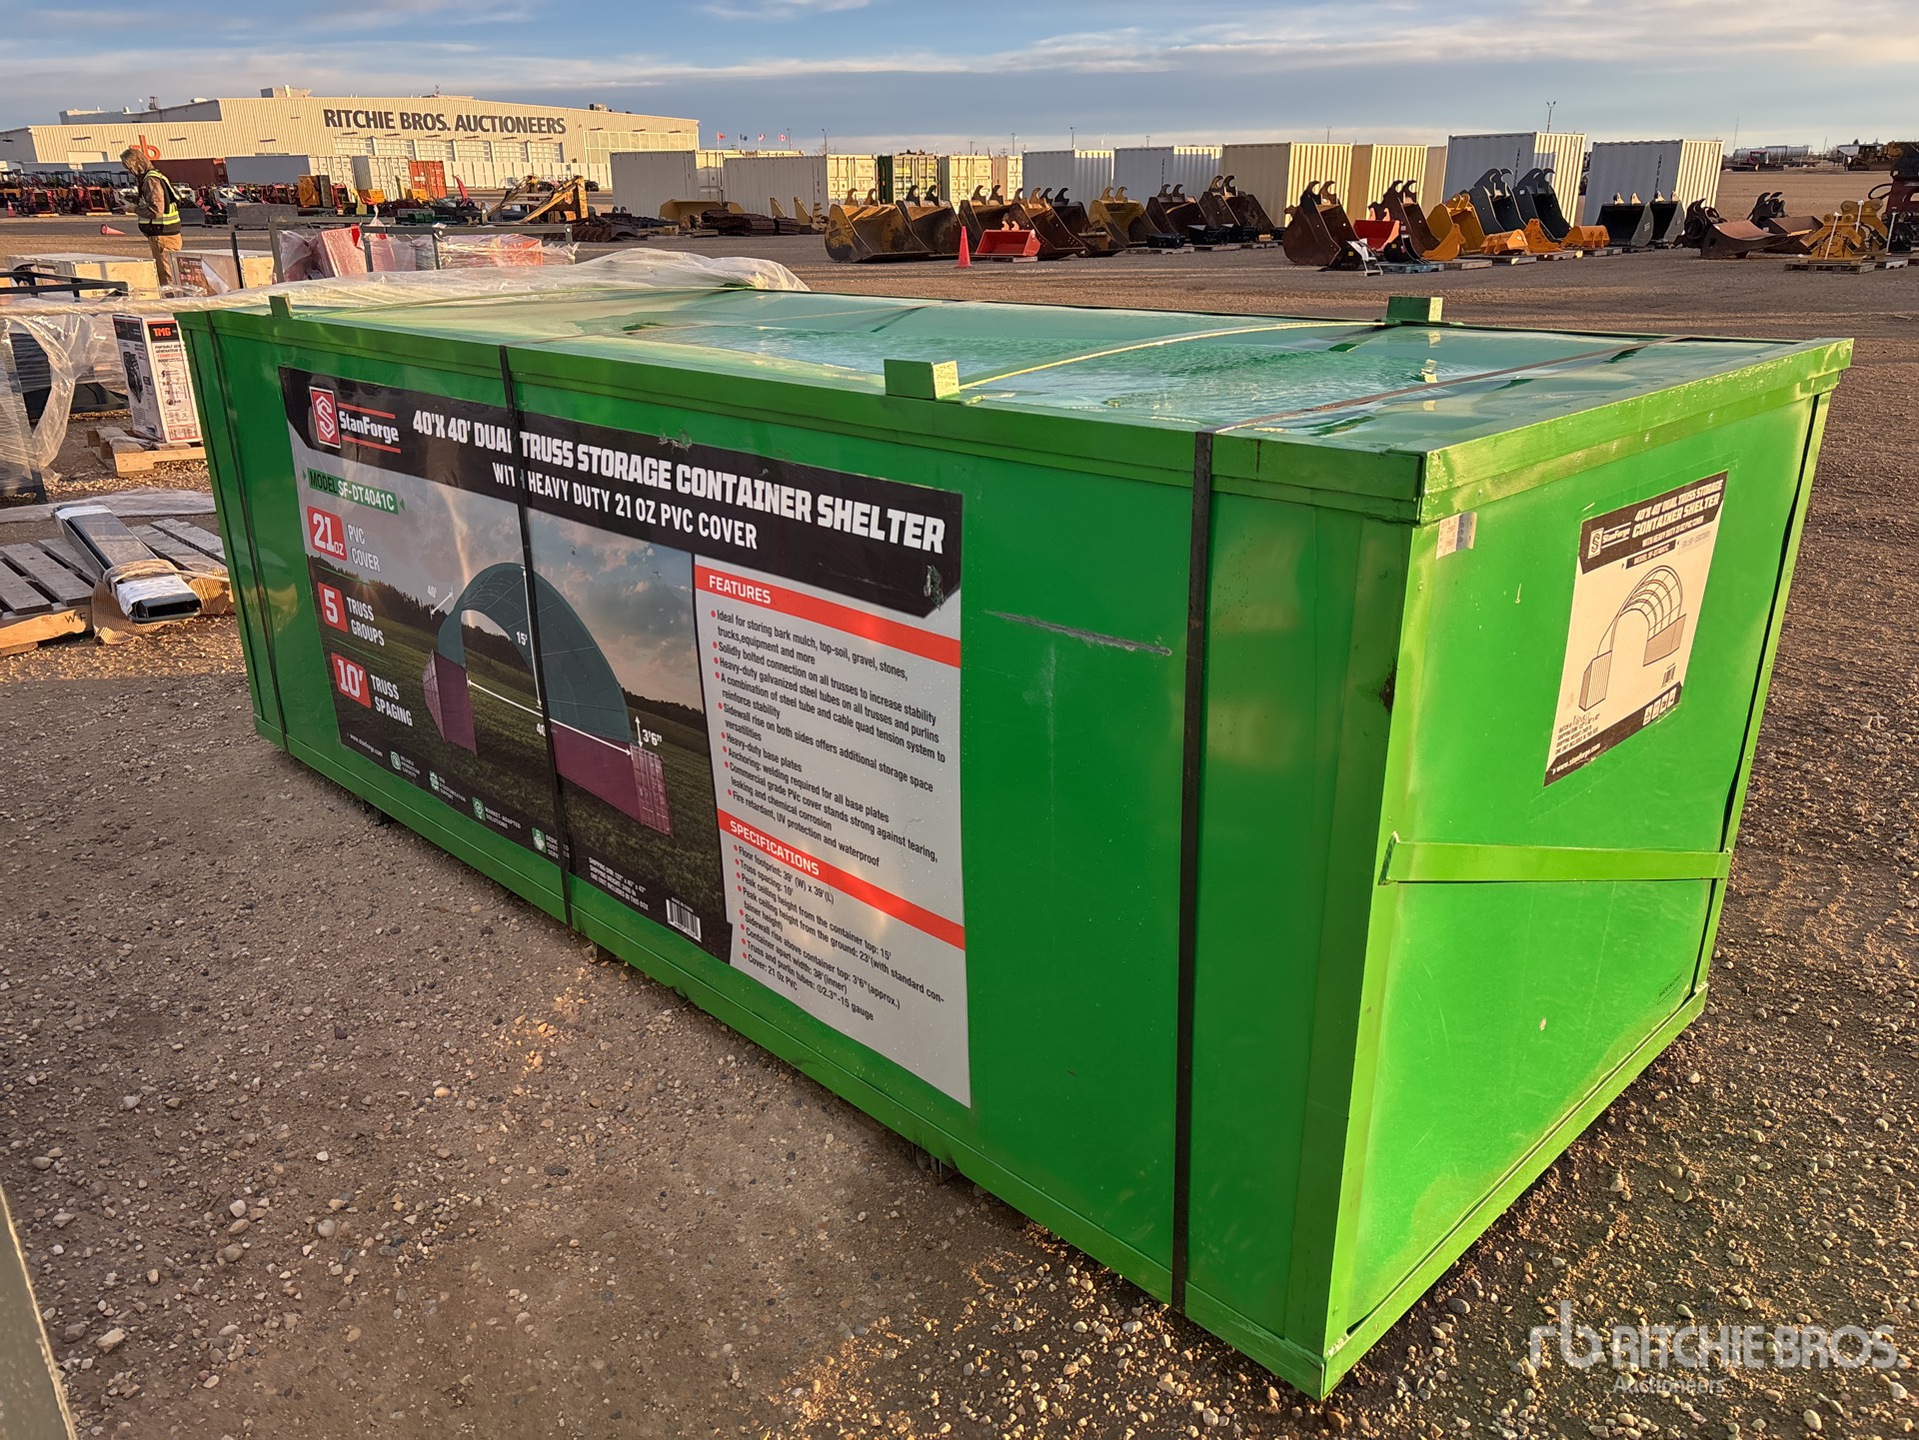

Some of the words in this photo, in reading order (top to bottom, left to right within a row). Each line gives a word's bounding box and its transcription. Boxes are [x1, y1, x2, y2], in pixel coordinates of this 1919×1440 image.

[324, 109, 395, 130] RITCHIE
[400, 112, 451, 131] BROS.
[454, 114, 566, 134] AUCTIONEERS
[153, 328, 171, 336] TMG
[338, 410, 399, 444] StanForge
[309, 470, 337, 494] MODEL
[337, 480, 394, 510] SF-DT4041C
[447, 417, 470, 443] 40'
[519, 431, 573, 468] TRUSS
[577, 444, 671, 490] STORAGE
[676, 464, 811, 523] CONTAINER
[817, 494, 945, 553] SHELTER
[527, 470, 568, 501] HEAVY
[572, 482, 609, 512] DUTY
[614, 493, 631, 518] 21
[635, 497, 656, 524] OZ
[660, 503, 693, 533] PVC
[698, 512, 756, 549] COVER
[1632, 507, 1683, 538] CONTAINER
[1683, 492, 1720, 518] SHELTER
[347, 524, 365, 544] PVC
[351, 547, 380, 572] COVER
[323, 588, 338, 623] 5
[346, 596, 374, 621] TRUSS
[709, 575, 770, 604] FEATURES
[350, 619, 384, 646] GROUPS
[716, 609, 734, 624] Ideal
[735, 614, 745, 627] for
[746, 620, 772, 638] storing
[774, 626, 791, 641] bark
[792, 634, 818, 651] mulch,
[819, 640, 850, 661] top-soil,
[851, 652, 878, 671] gravel,
[879, 661, 907, 681] stones,
[780, 646, 794, 658] and
[796, 651, 815, 665] more
[337, 659, 363, 698] 10'
[370, 674, 399, 700] TRUSS
[718, 641, 741, 659] Solidly
[742, 649, 765, 665] bolted
[766, 658, 806, 678] connection
[808, 672, 818, 682] on
[819, 674, 829, 686] all
[830, 677, 858, 696] trusses
[859, 687, 867, 699] to
[869, 690, 902, 712] increase
[904, 705, 936, 726] stability
[719, 656, 757, 680] Heavy-duty
[759, 672, 798, 692] galvanized
[799, 685, 817, 698] steel
[819, 690, 840, 706] tubes
[841, 699, 851, 710] on
[853, 702, 863, 714] all
[864, 706, 892, 725] trusses
[894, 719, 909, 732] and
[911, 725, 939, 743] purlins
[721, 672, 726, 683] A
[726, 676, 768, 698] combination
[770, 691, 777, 701] of
[779, 694, 797, 708] steel
[798, 699, 815, 714] tube
[816, 707, 831, 720] and
[832, 713, 853, 728] cable
[855, 721, 874, 735] quad
[876, 727, 904, 747] tension
[906, 740, 935, 759] system
[937, 750, 945, 763] to
[722, 689, 751, 707] reinforce
[752, 700, 780, 719] stability
[723, 702, 750, 722] Sidewall
[751, 715, 764, 728] rise
[766, 721, 775, 731] on
[776, 723, 792, 738] both
[794, 730, 814, 746] sides
[815, 738, 837, 754] offers
[839, 748, 877, 769] additional
[878, 762, 908, 782] storage
[909, 775, 933, 792] space
[724, 719, 762, 741] versatilities
[726, 732, 761, 758] Heavy-duty
[762, 748, 779, 763] base
[780, 756, 802, 772] plates
[729, 761, 766, 786] Commercial
[767, 781, 786, 796] grade
[802, 796, 822, 810] cover
[823, 805, 848, 822] stands
[850, 816, 875, 835] strong
[876, 827, 906, 847] against
[907, 838, 937, 862] tearing,
[730, 776, 753, 796] leaking
[754, 789, 766, 801] and
[767, 795, 797, 815] chemical
[798, 809, 832, 831] corrosion
[762, 764, 789, 784] welding
[790, 776, 820, 795] required
[821, 787, 832, 800] for
[833, 793, 843, 804] all
[845, 796, 863, 812] base
[865, 806, 889, 823] plates
[730, 820, 819, 875] SPECIFICATIONS
[732, 790, 744, 804] Fire
[745, 798, 775, 821] retardant,
[776, 812, 785, 824] UV
[787, 819, 821, 841] protection
[823, 835, 836, 848] and
[838, 842, 879, 867] waterproof
[782, 880, 794, 898] 10'
[794, 876, 806, 891] (W)
[741, 872, 756, 888] Peak
[798, 906, 814, 922] from
[816, 915, 827, 928] the
[829, 923, 862, 946] container
[864, 939, 878, 954] top:
[742, 886, 757, 902] Peak
[799, 920, 816, 936] from
[817, 929, 828, 942] the
[830, 937, 858, 957] ground:
[890, 969, 924, 994] standard
[926, 988, 944, 1002] con-
[744, 913, 770, 935] Sidewall
[783, 938, 801, 955] above
[802, 950, 835, 973] container
[836, 966, 850, 981] top:
[745, 926, 774, 950] Container
[747, 953, 766, 971] Cover:
[767, 965, 775, 976] 21
[785, 975, 797, 991] PVC
[765, 952, 776, 964] and
[851, 1003, 873, 1021] gauge
